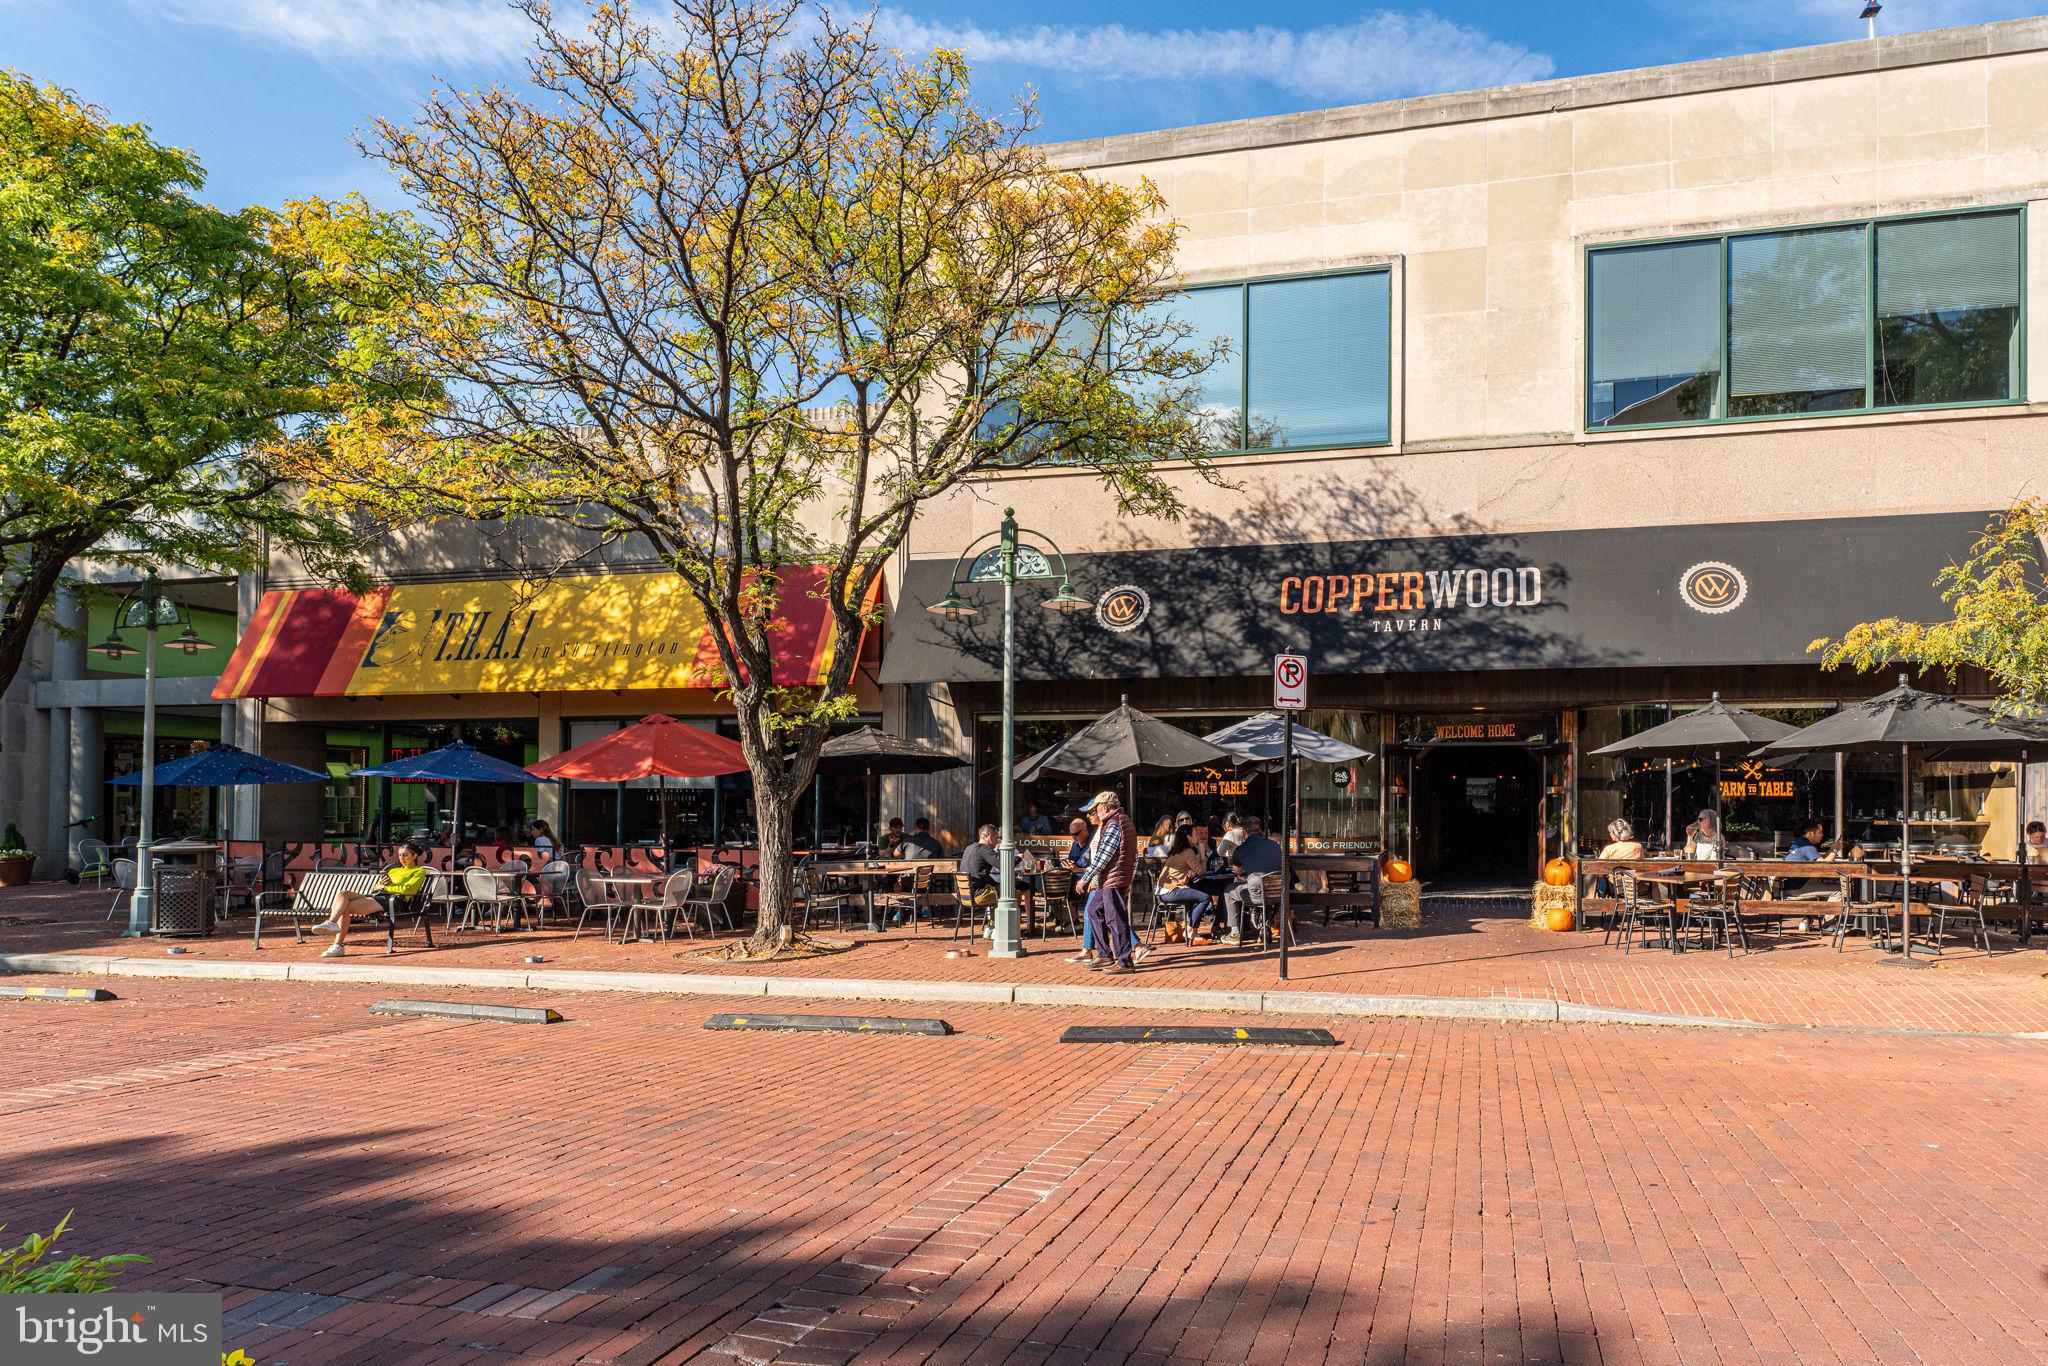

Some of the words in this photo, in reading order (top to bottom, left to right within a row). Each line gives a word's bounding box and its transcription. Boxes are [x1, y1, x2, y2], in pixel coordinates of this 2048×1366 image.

[1280, 567, 1541, 614] COPPERWOOD
[1373, 618, 1442, 632] TAVERN
[532, 643, 550, 659] in
[560, 639, 679, 658] Shirlington
[1437, 724, 1484, 739] WELCOME
[1487, 723, 1515, 737] HOME
[1183, 781, 1208, 795] FARM
[1218, 781, 1248, 796] TABLE
[1759, 781, 1793, 797] TABLE
[1018, 839, 1047, 847] LOCAL
[1307, 841, 1330, 849] DOG
[1333, 841, 1374, 849] FRIENDLY
